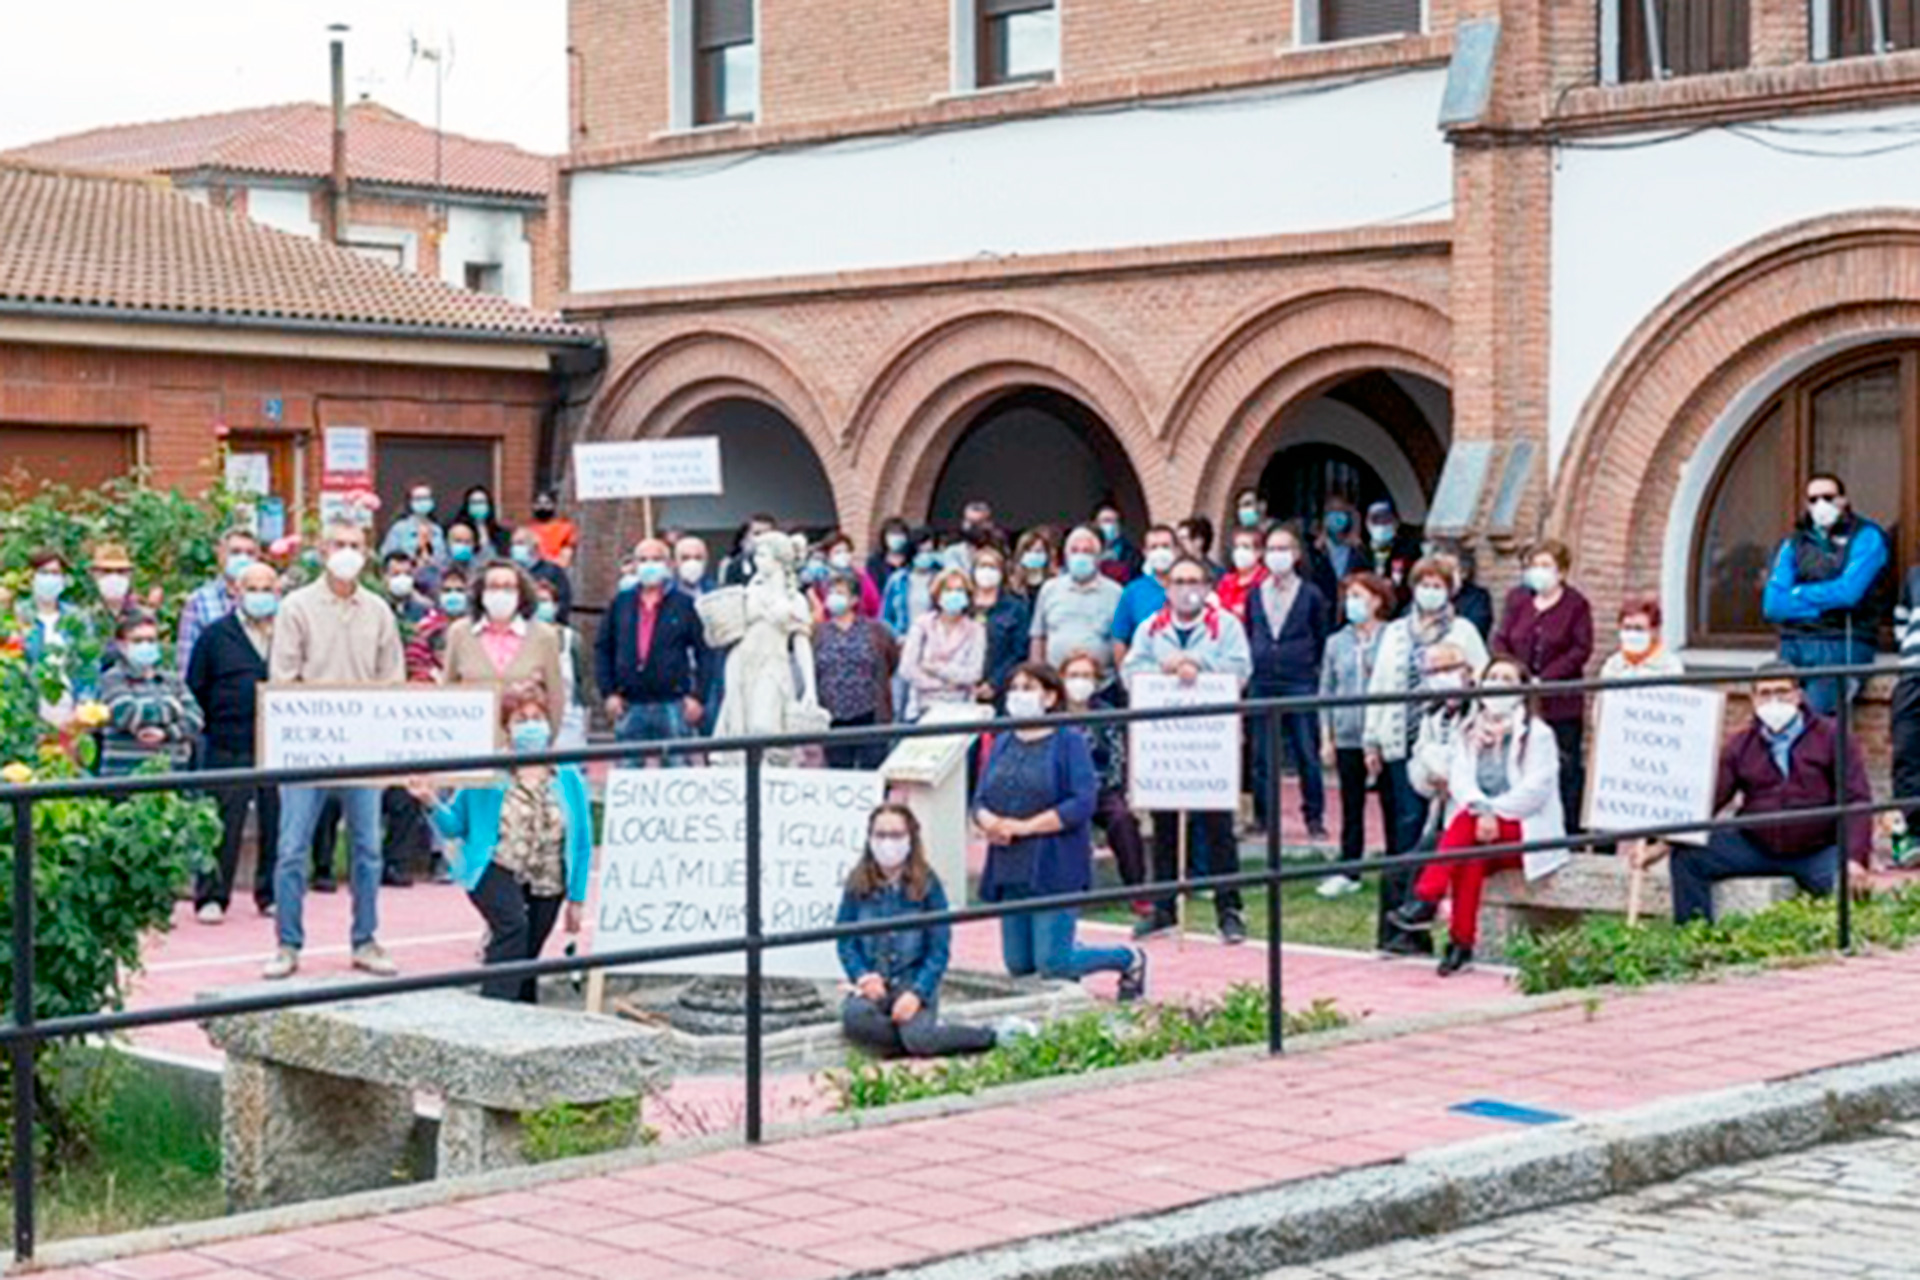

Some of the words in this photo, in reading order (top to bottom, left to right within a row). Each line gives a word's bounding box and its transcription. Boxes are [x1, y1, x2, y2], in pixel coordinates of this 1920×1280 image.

[270, 700, 363, 716] SANIDAD
[373, 704, 397, 720] LA
[402, 704, 484, 720] SANIDAD
[1624, 707, 1685, 726] SOMOS
[280, 726, 349, 743] RURAL
[402, 727, 423, 742] ES
[427, 727, 454, 742] UN
[1622, 727, 1682, 750] TODOS
[283, 752, 347, 769] DIGNA
[1135, 778, 1229, 792] NECESIDAD
[1600, 775, 1691, 801] PERSONAL
[611, 779, 661, 808] SIN
[663, 778, 875, 812] CONSTORIOS
[778, 820, 864, 851] IGUAL
[603, 861, 622, 889] A
[629, 858, 668, 889] LA
[599, 903, 654, 934] LAS
